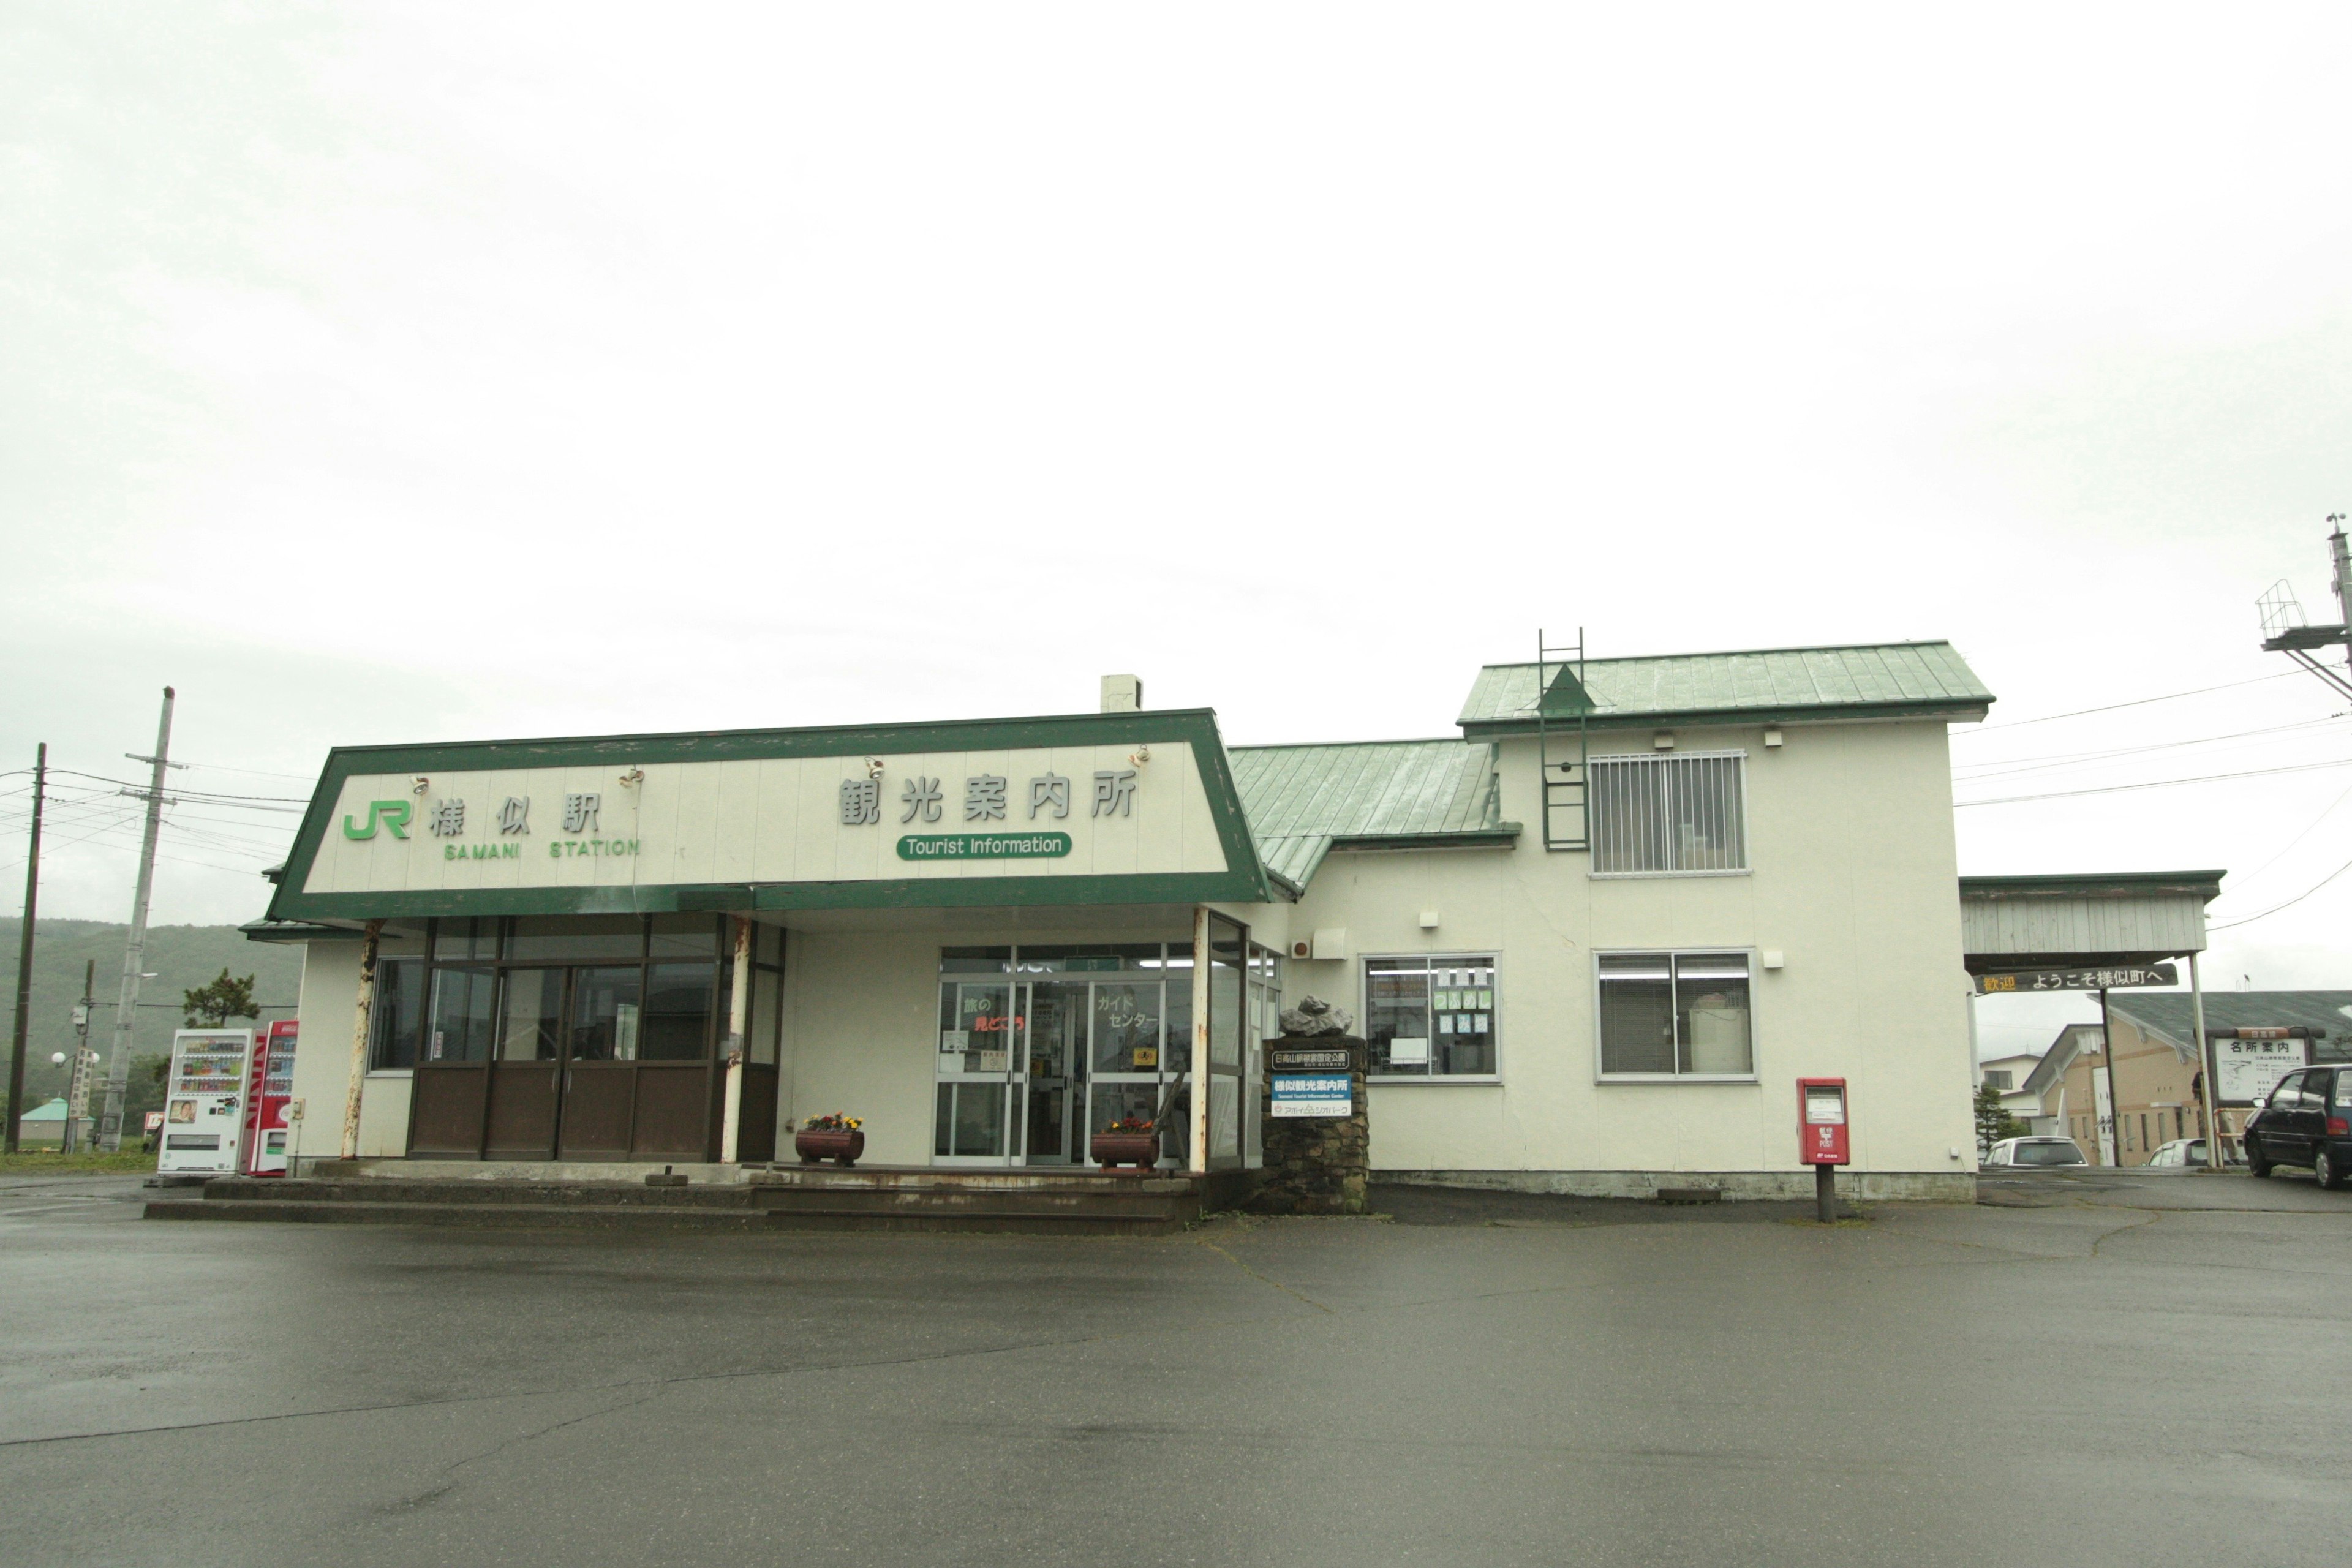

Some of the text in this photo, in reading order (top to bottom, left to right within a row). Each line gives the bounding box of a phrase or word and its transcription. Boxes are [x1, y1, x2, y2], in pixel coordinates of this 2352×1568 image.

[839, 770, 1136, 824] 観光案内所
[344, 793, 600, 840] JR 様似駅
[445, 839, 640, 860] SAMANI STATION
[907, 836, 1063, 855] Tourist Information
[1984, 970, 2163, 991] 歓迎 ようこそ様似町へ
[964, 998, 991, 1013] 旅の
[1098, 996, 1133, 1011] ガイド
[974, 1016, 1025, 1031] 見どころ
[1109, 1012, 1158, 1028] センター
[2230, 1042, 2289, 1053] 名所案内
[1275, 1080, 1348, 1091] 様似観光案内所
